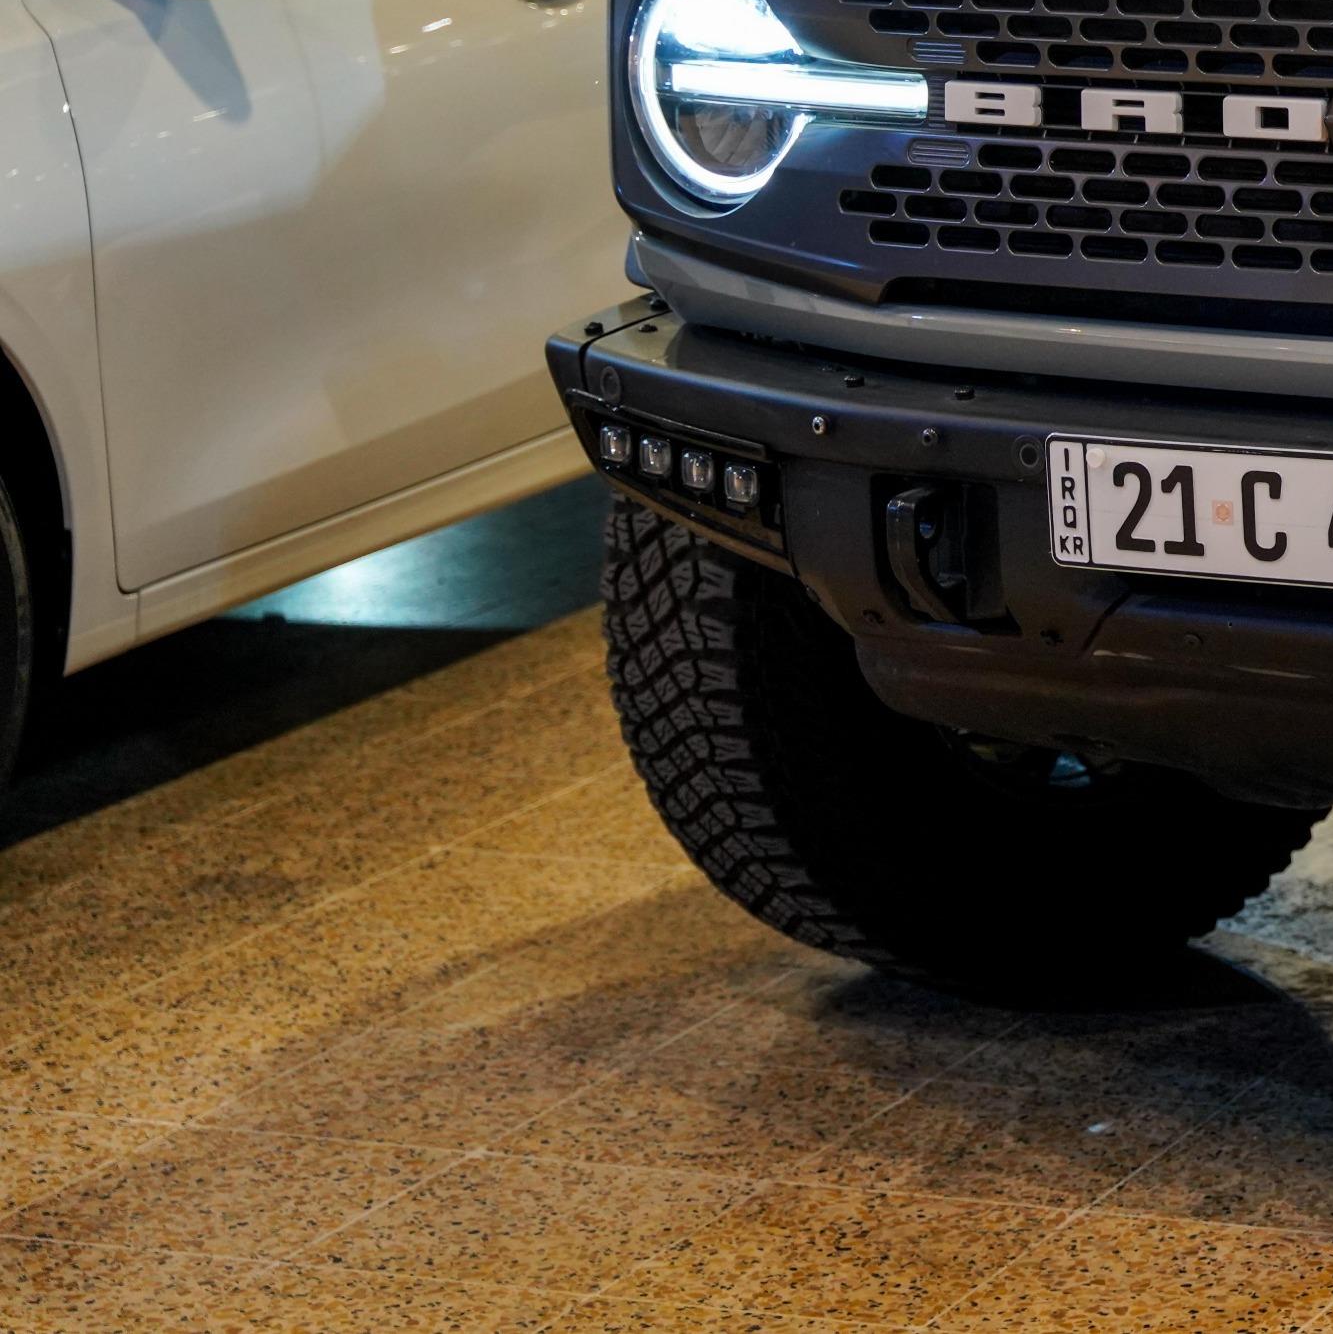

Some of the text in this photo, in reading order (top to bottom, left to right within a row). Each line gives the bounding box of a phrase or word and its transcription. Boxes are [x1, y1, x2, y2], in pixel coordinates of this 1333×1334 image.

[1112, 461, 1205, 556] 21
[1240, 470, 1288, 561] C
[1059, 535, 1085, 556] KR
